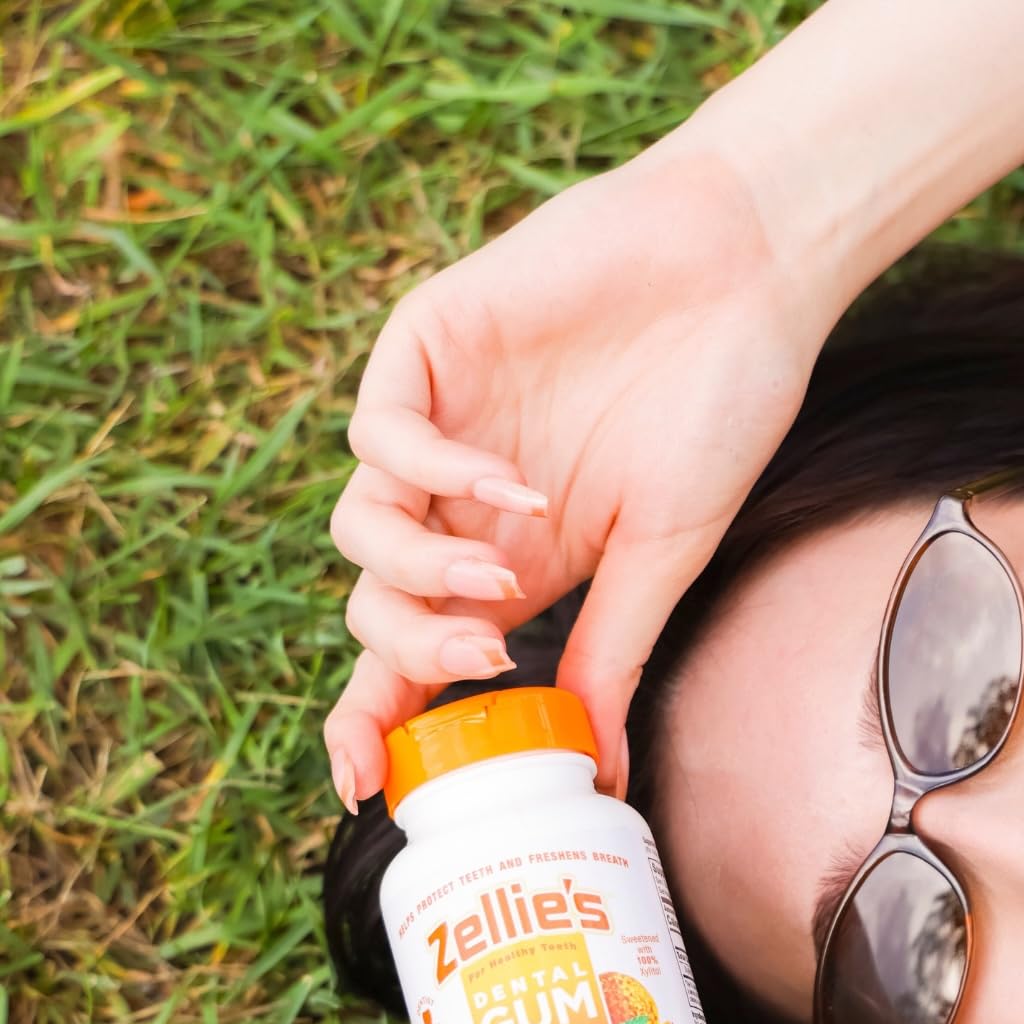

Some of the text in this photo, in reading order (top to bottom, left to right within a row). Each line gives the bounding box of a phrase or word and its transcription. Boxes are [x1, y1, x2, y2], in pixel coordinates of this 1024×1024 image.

[416, 881, 454, 914] PROTECT
[459, 865, 493, 886] TEETH
[499, 856, 522, 871] AND
[528, 851, 587, 863] FRESHENS
[592, 852, 629, 869] BREATH
[427, 879, 611, 984] Zellie's
[489, 946, 536, 969] Healthy
[540, 941, 577, 953] Teeth
[473, 961, 588, 1009] DENTAL
